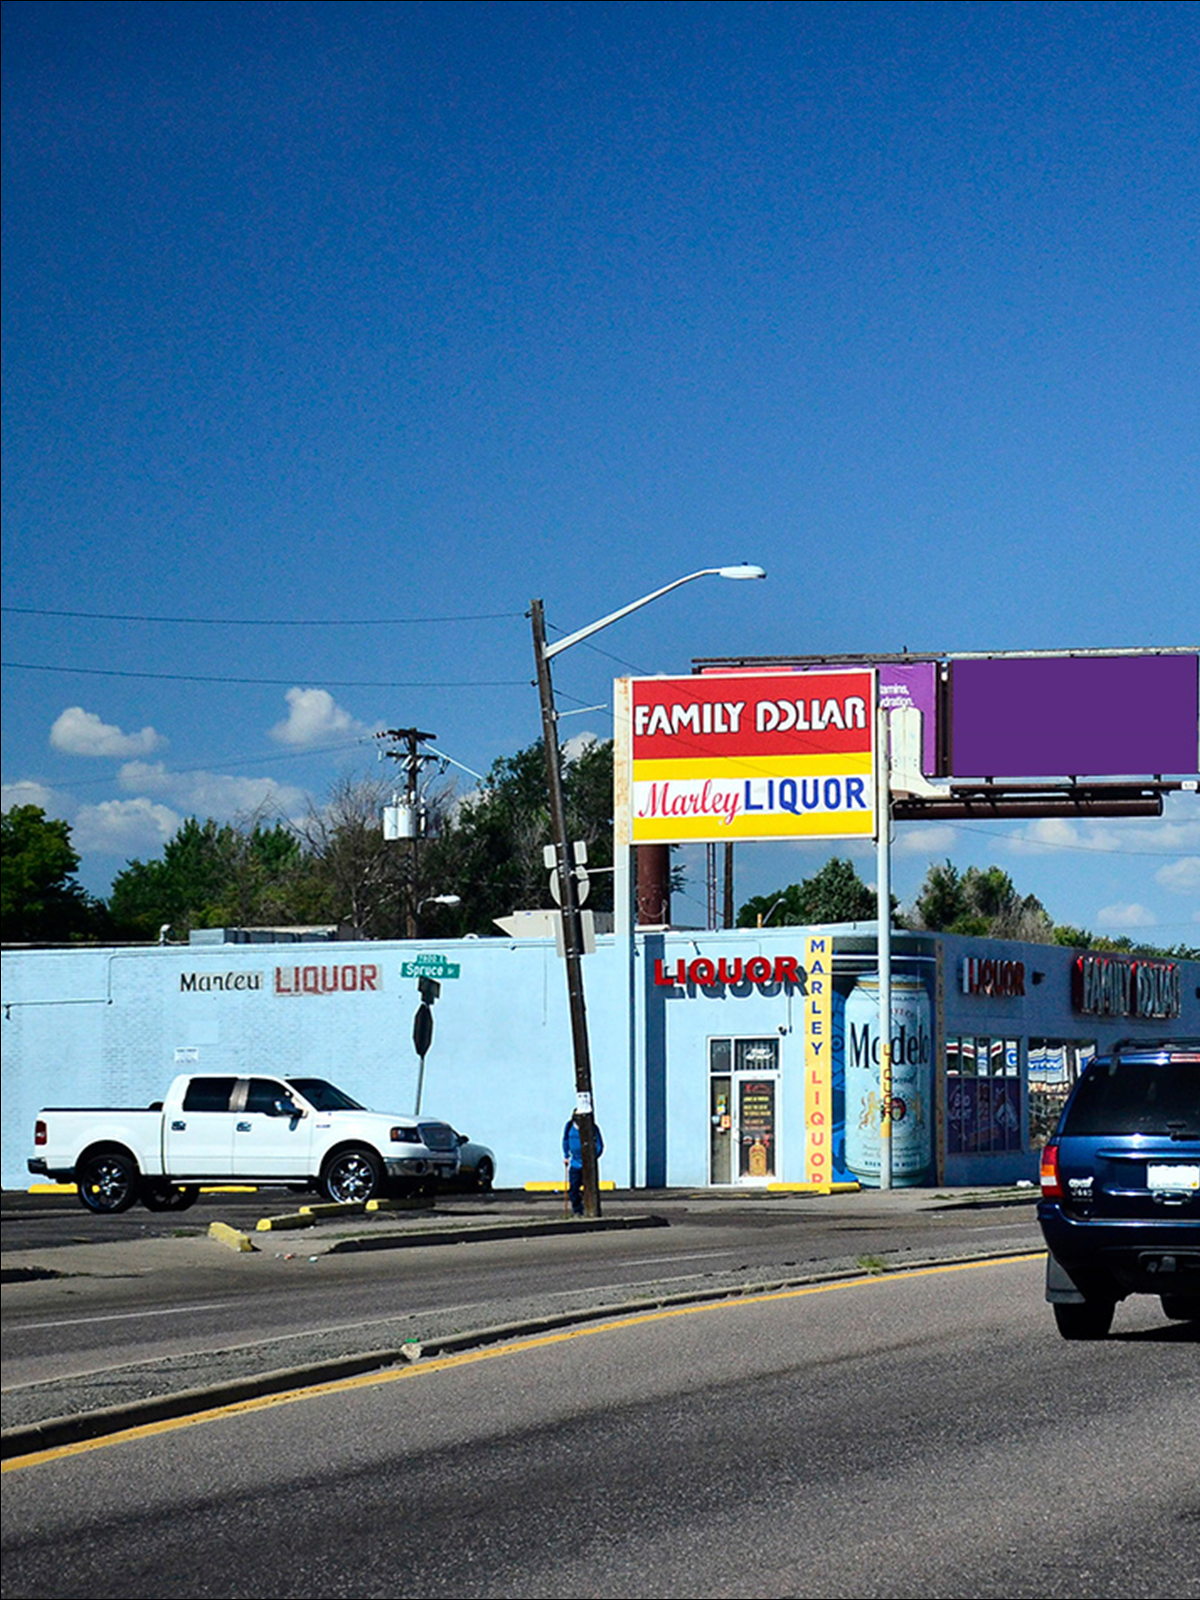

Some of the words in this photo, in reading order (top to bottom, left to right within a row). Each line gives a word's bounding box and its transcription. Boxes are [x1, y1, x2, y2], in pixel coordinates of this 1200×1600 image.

[634, 702, 745, 736] FAMILY
[756, 696, 867, 732] DOLLAR
[638, 779, 743, 825] Marley
[744, 777, 867, 815] LIQUOR
[275, 965, 377, 994] LIQUOR
[406, 961, 443, 977] Spruce
[654, 956, 800, 987] LIQUOR
[811, 939, 825, 1056] MARLEY
